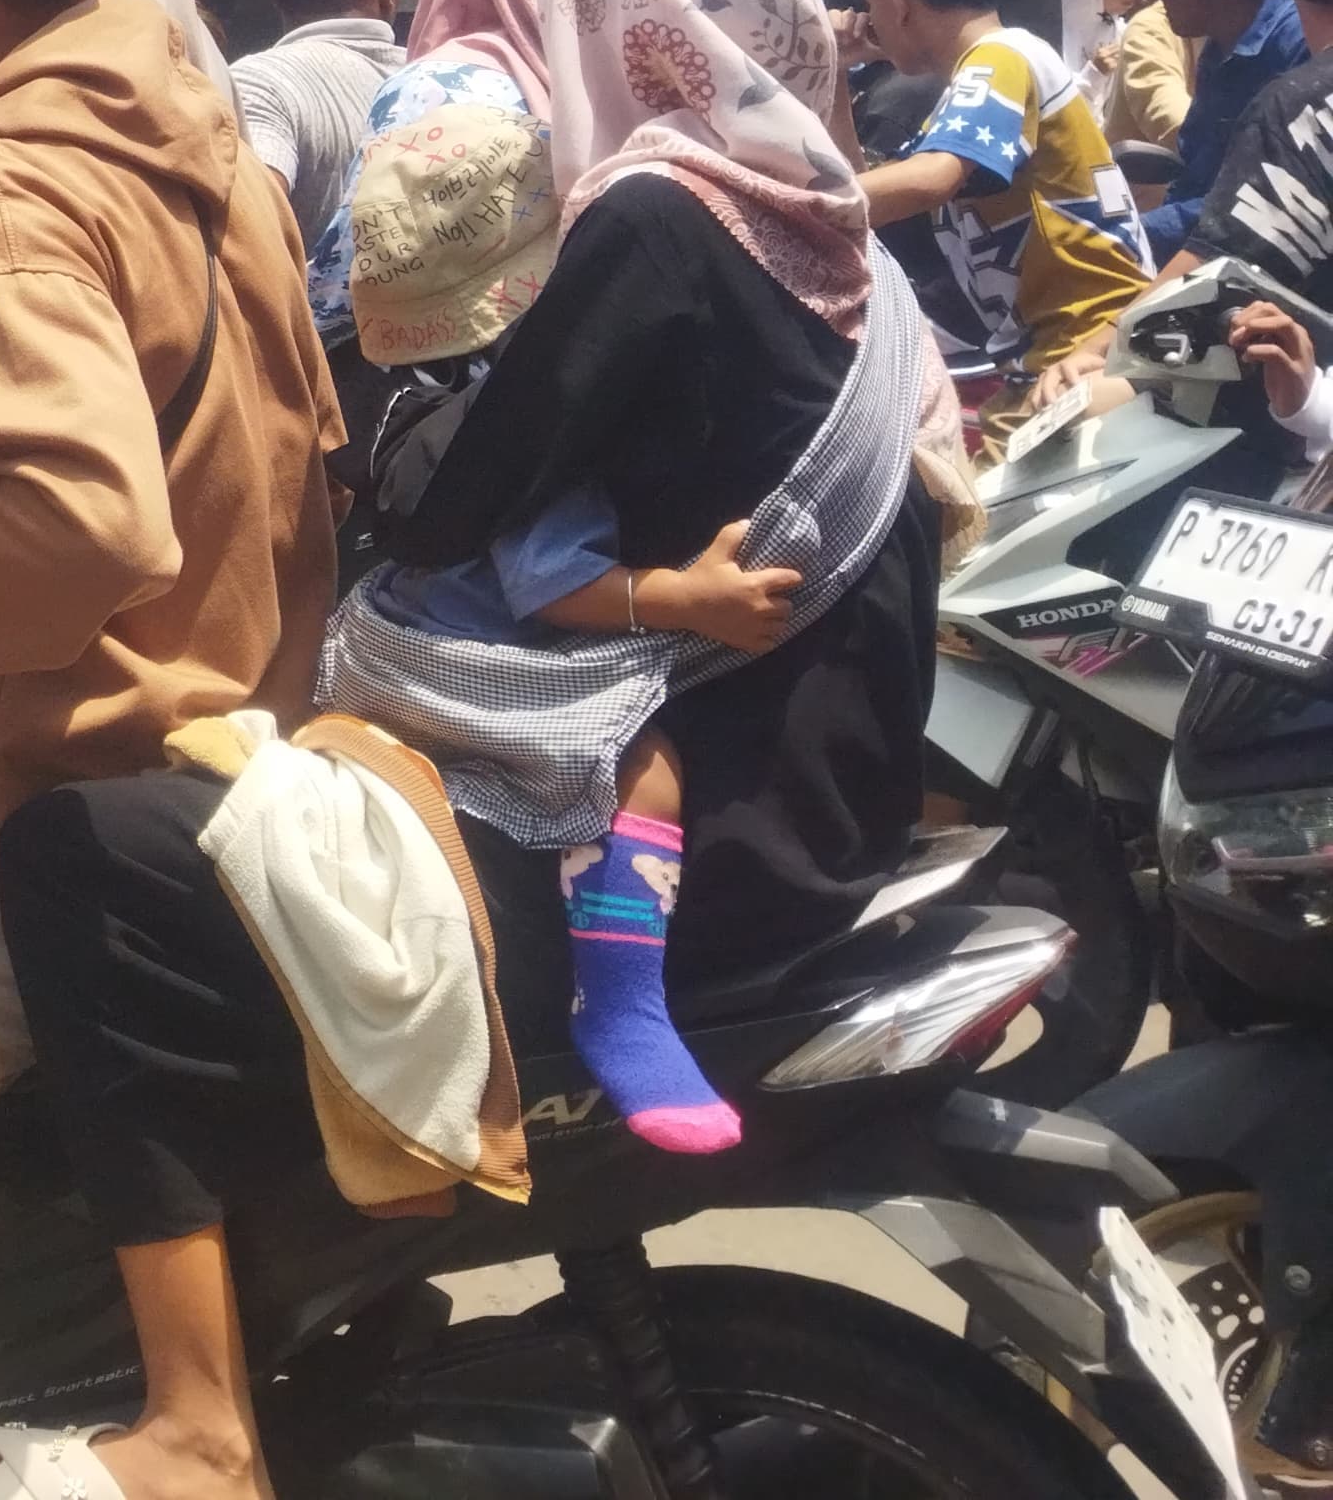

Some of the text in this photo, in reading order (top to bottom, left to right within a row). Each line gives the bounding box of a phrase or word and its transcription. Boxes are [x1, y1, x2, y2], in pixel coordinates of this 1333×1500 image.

[355, 226, 401, 254] ASTE
[359, 242, 413, 272] OUR
[363, 257, 425, 286] OUNG
[1168, 510, 1200, 555] P
[1201, 518, 1289, 579] 3769
[1016, 599, 1117, 629] HONDA
[1205, 631, 1312, 669] SEMAKIN DI DEPAN
